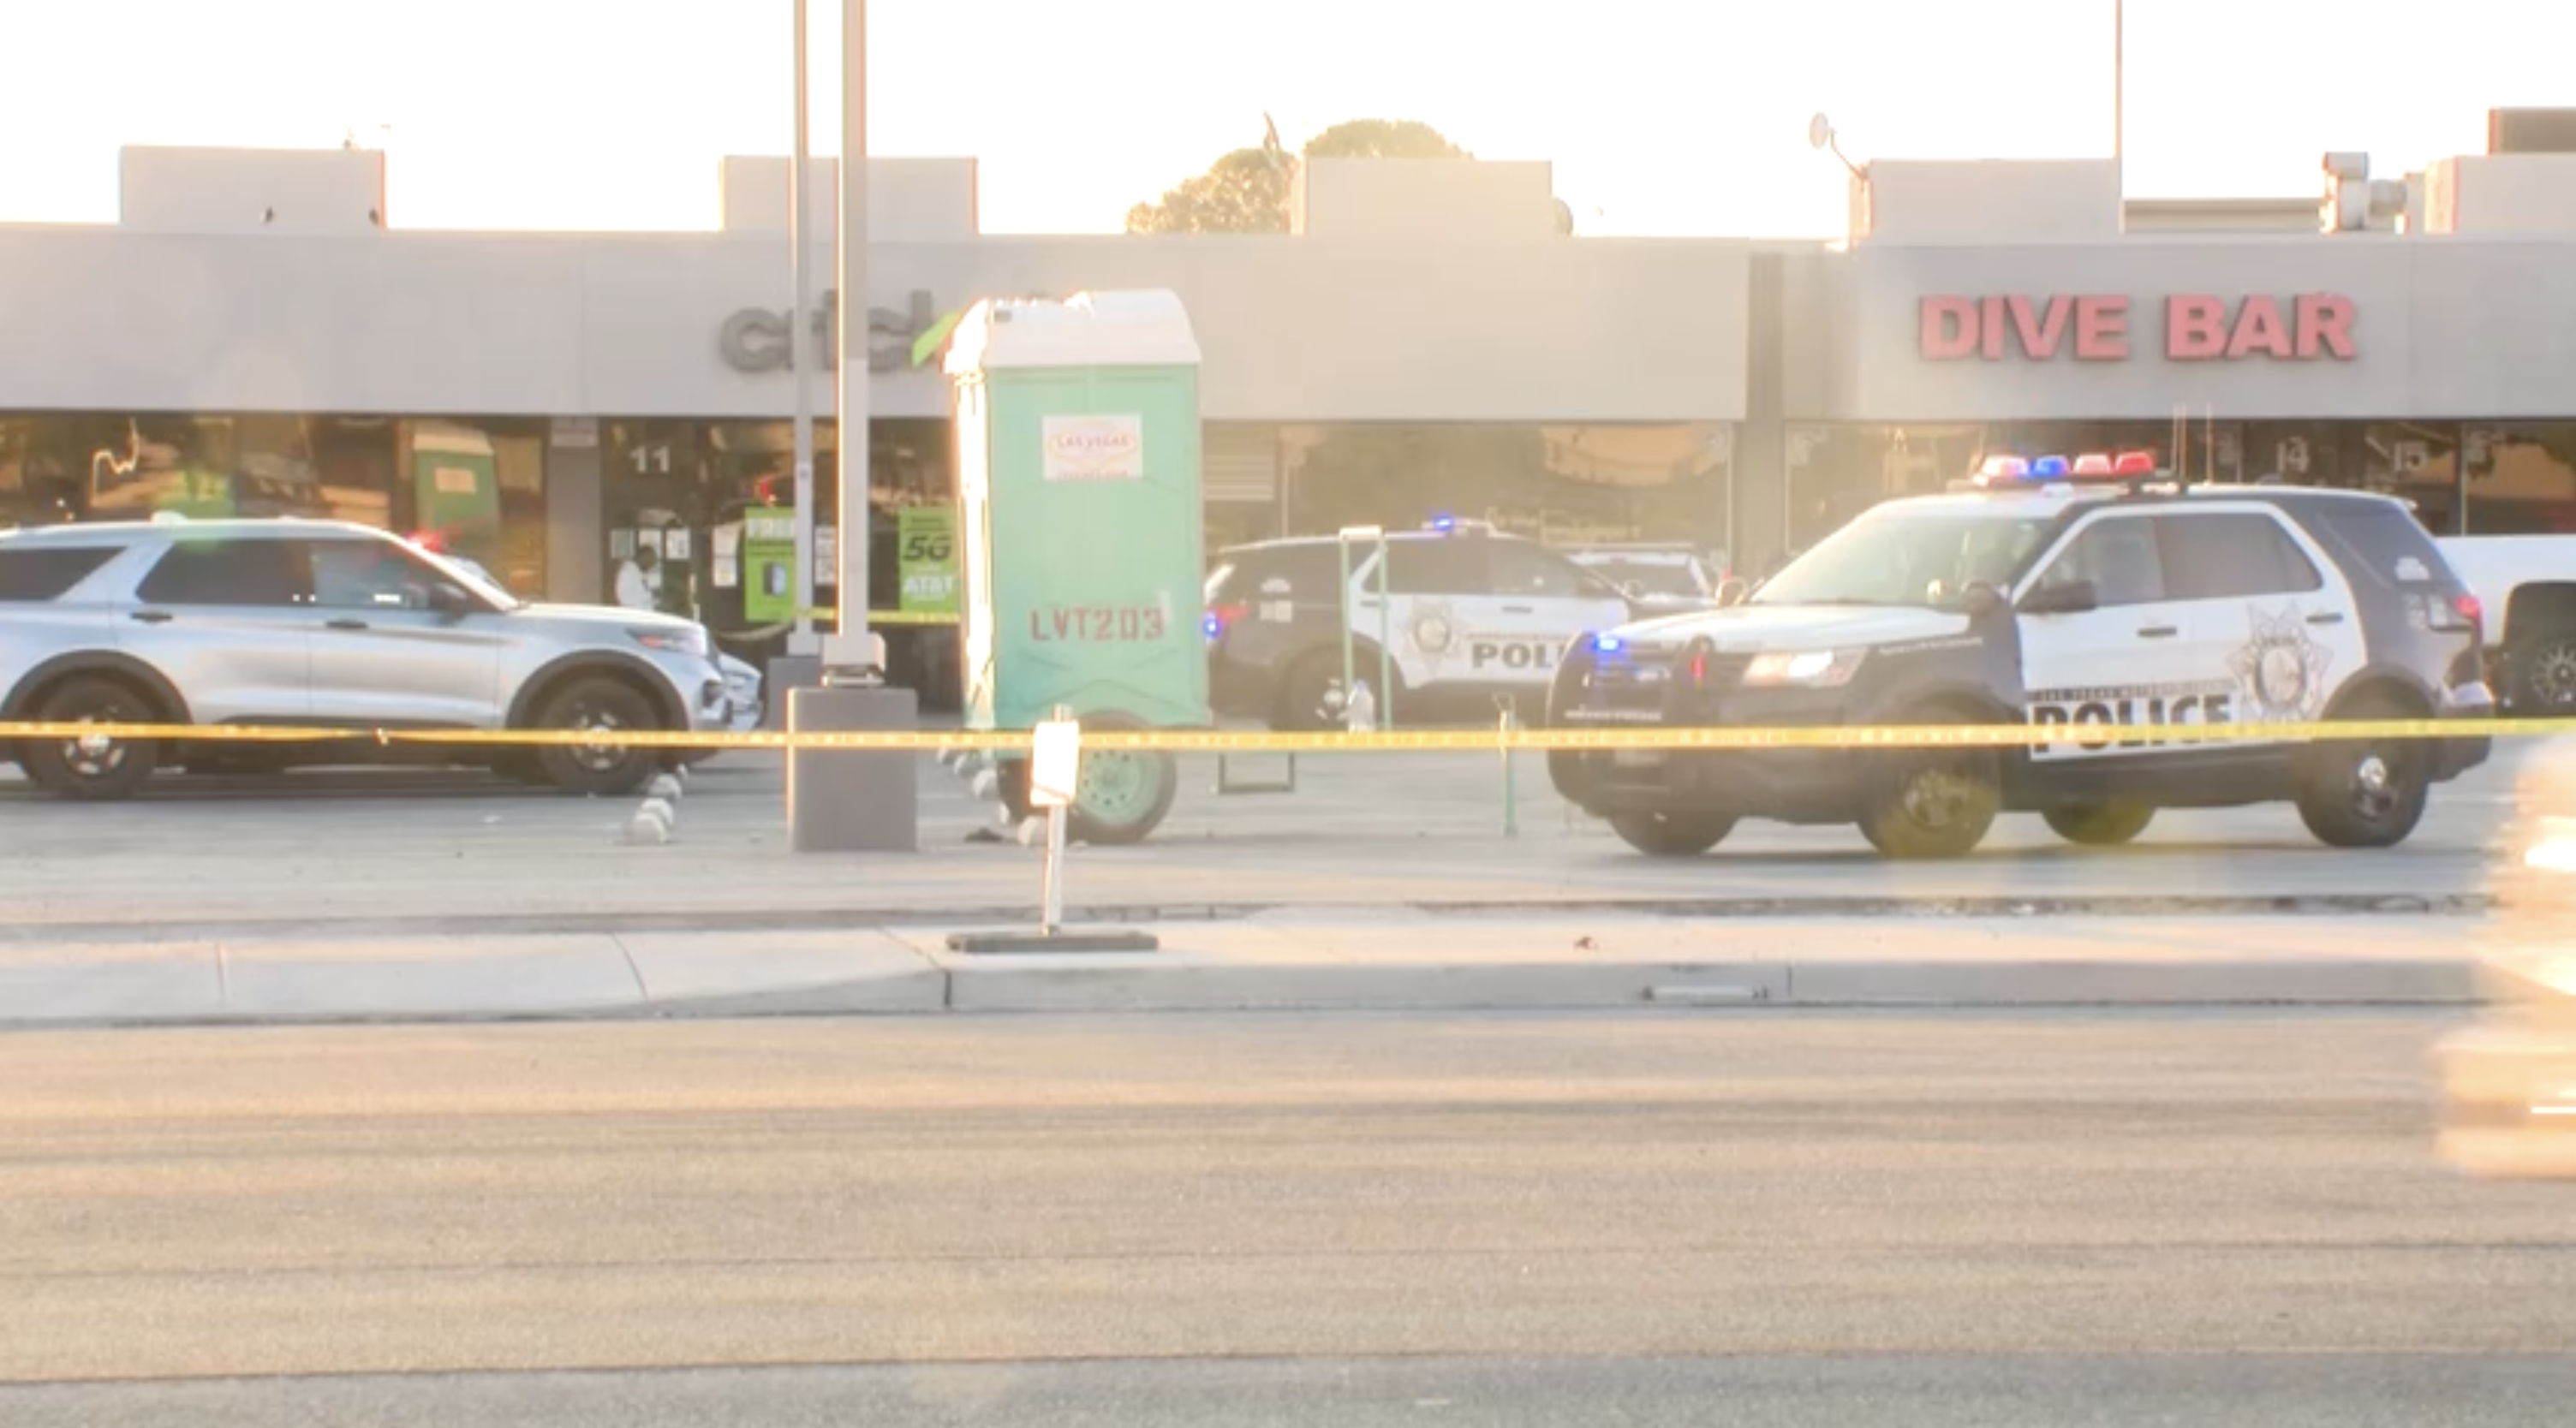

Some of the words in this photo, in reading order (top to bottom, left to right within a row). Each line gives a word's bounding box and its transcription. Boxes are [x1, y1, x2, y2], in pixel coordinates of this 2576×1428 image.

[1917, 294, 2130, 360] DIVE
[2163, 293, 2357, 360] BAR
[1056, 434, 1083, 448] LAS
[629, 445, 671, 473] 11
[902, 534, 952, 562] 5G
[1029, 606, 1166, 641] LVT203
[1471, 642, 1566, 669] POL
[2032, 694, 2232, 753] POLICE
